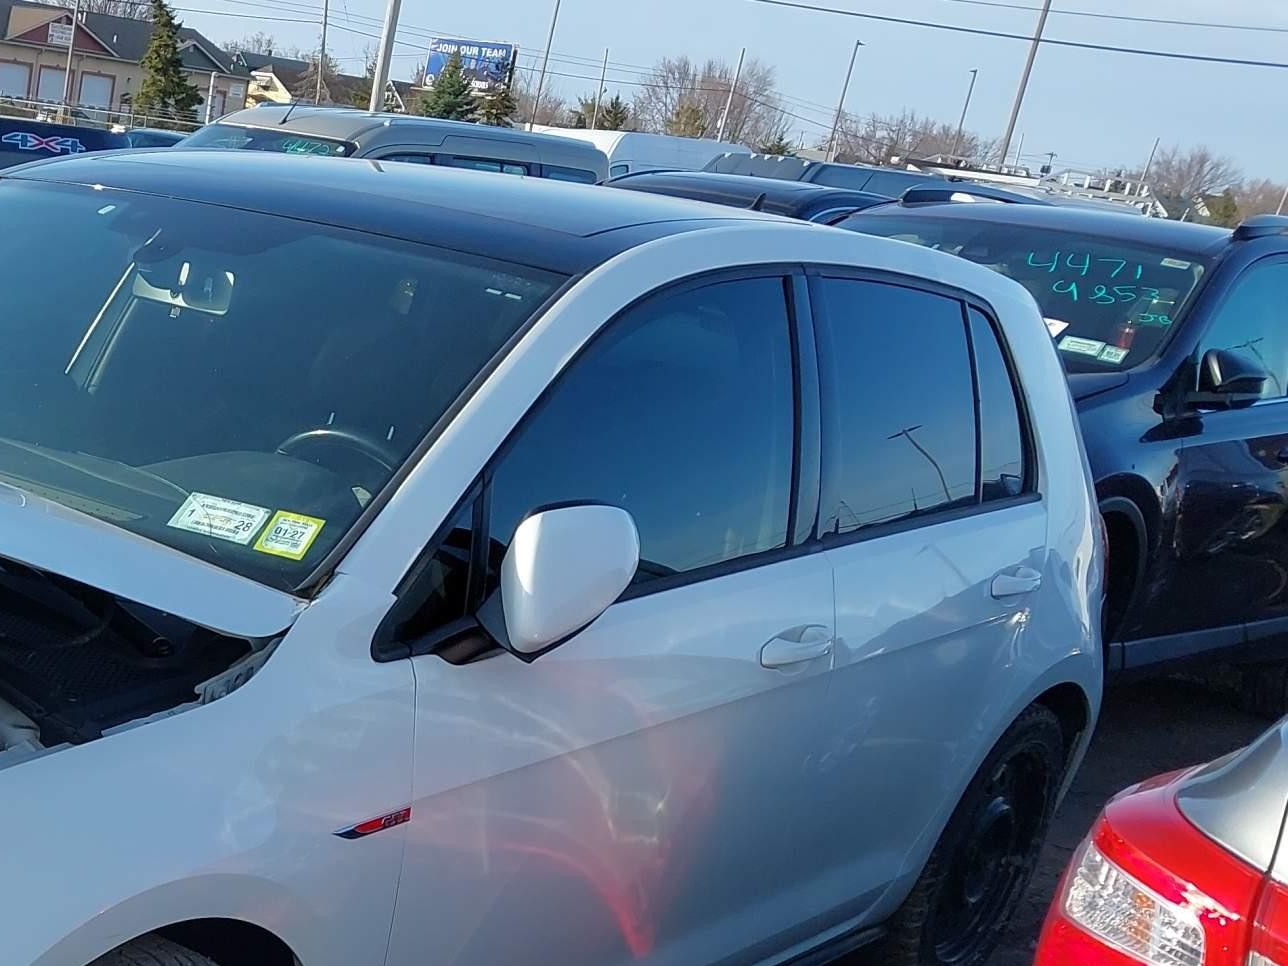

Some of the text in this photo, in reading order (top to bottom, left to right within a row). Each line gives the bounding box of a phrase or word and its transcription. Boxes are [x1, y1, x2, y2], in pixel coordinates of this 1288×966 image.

[437, 43, 506, 57] JOIN OUR TEAM
[1027, 251, 1142, 279] 4471
[234, 520, 253, 532] 28
[274, 526, 306, 540] 01-27
